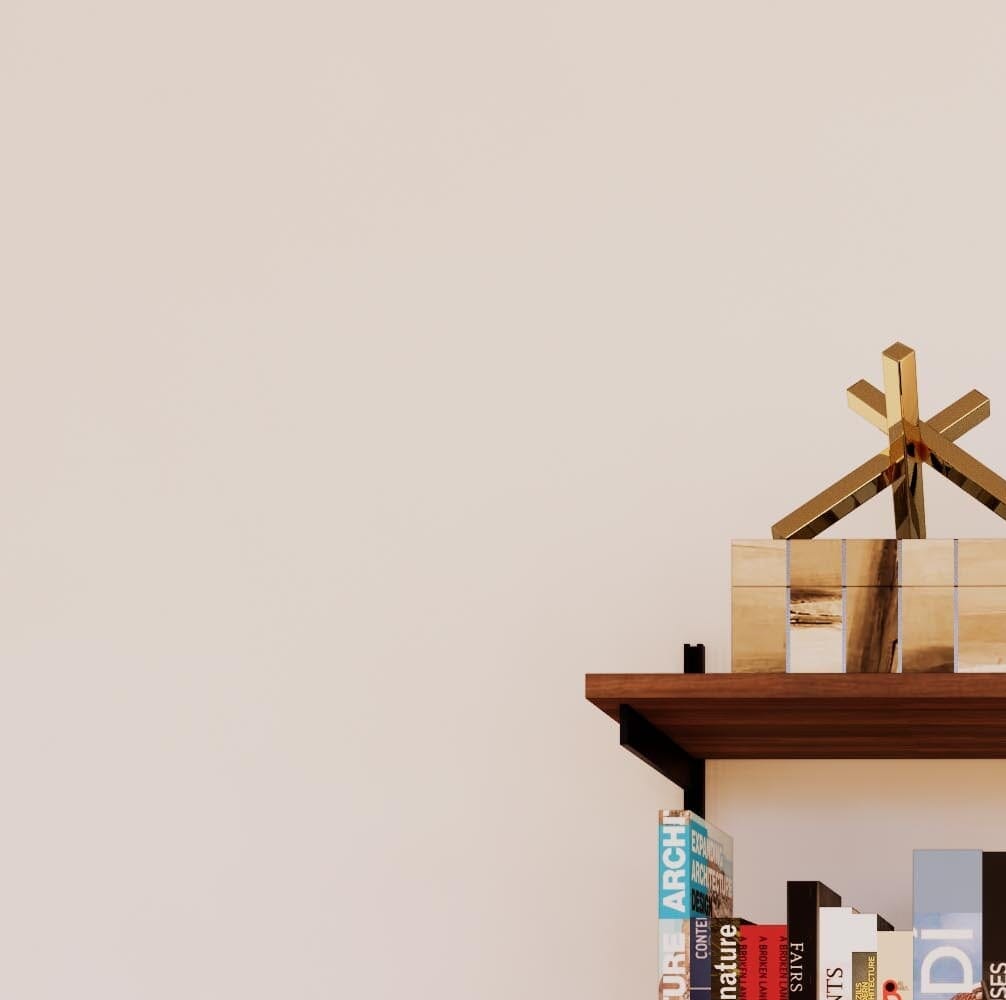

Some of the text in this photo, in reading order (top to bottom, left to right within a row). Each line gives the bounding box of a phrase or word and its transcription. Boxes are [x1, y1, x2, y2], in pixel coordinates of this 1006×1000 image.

[691, 859, 733, 898] ARCHITECTURE
[695, 917, 708, 959] CONTE
[759, 944, 768, 979] BROKEN
[779, 944, 788, 979] BROKEN
[789, 942, 804, 992] FAIRS
